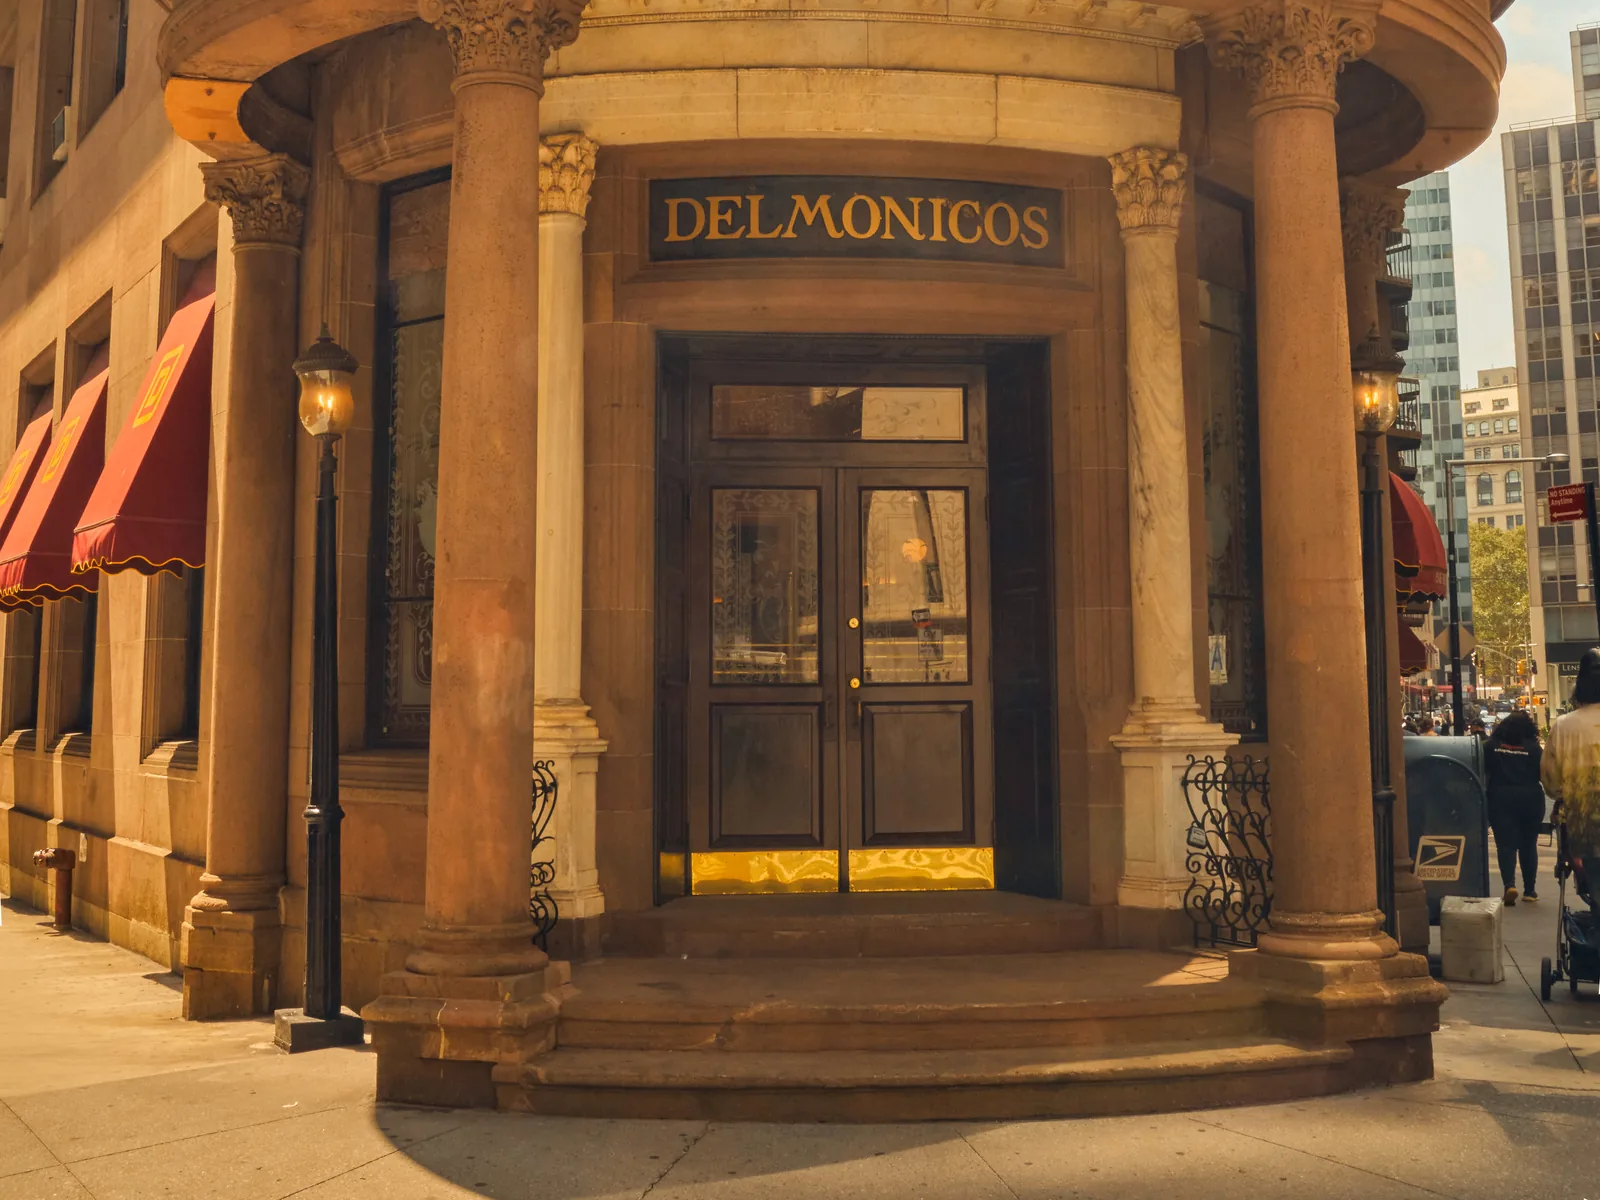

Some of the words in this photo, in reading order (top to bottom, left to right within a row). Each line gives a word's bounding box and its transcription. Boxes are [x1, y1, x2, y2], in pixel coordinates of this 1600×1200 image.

[663, 192, 1050, 249] DELMONICOS
[1559, 487, 1586, 497] STANDING
[1551, 497, 1573, 506] Anytime
